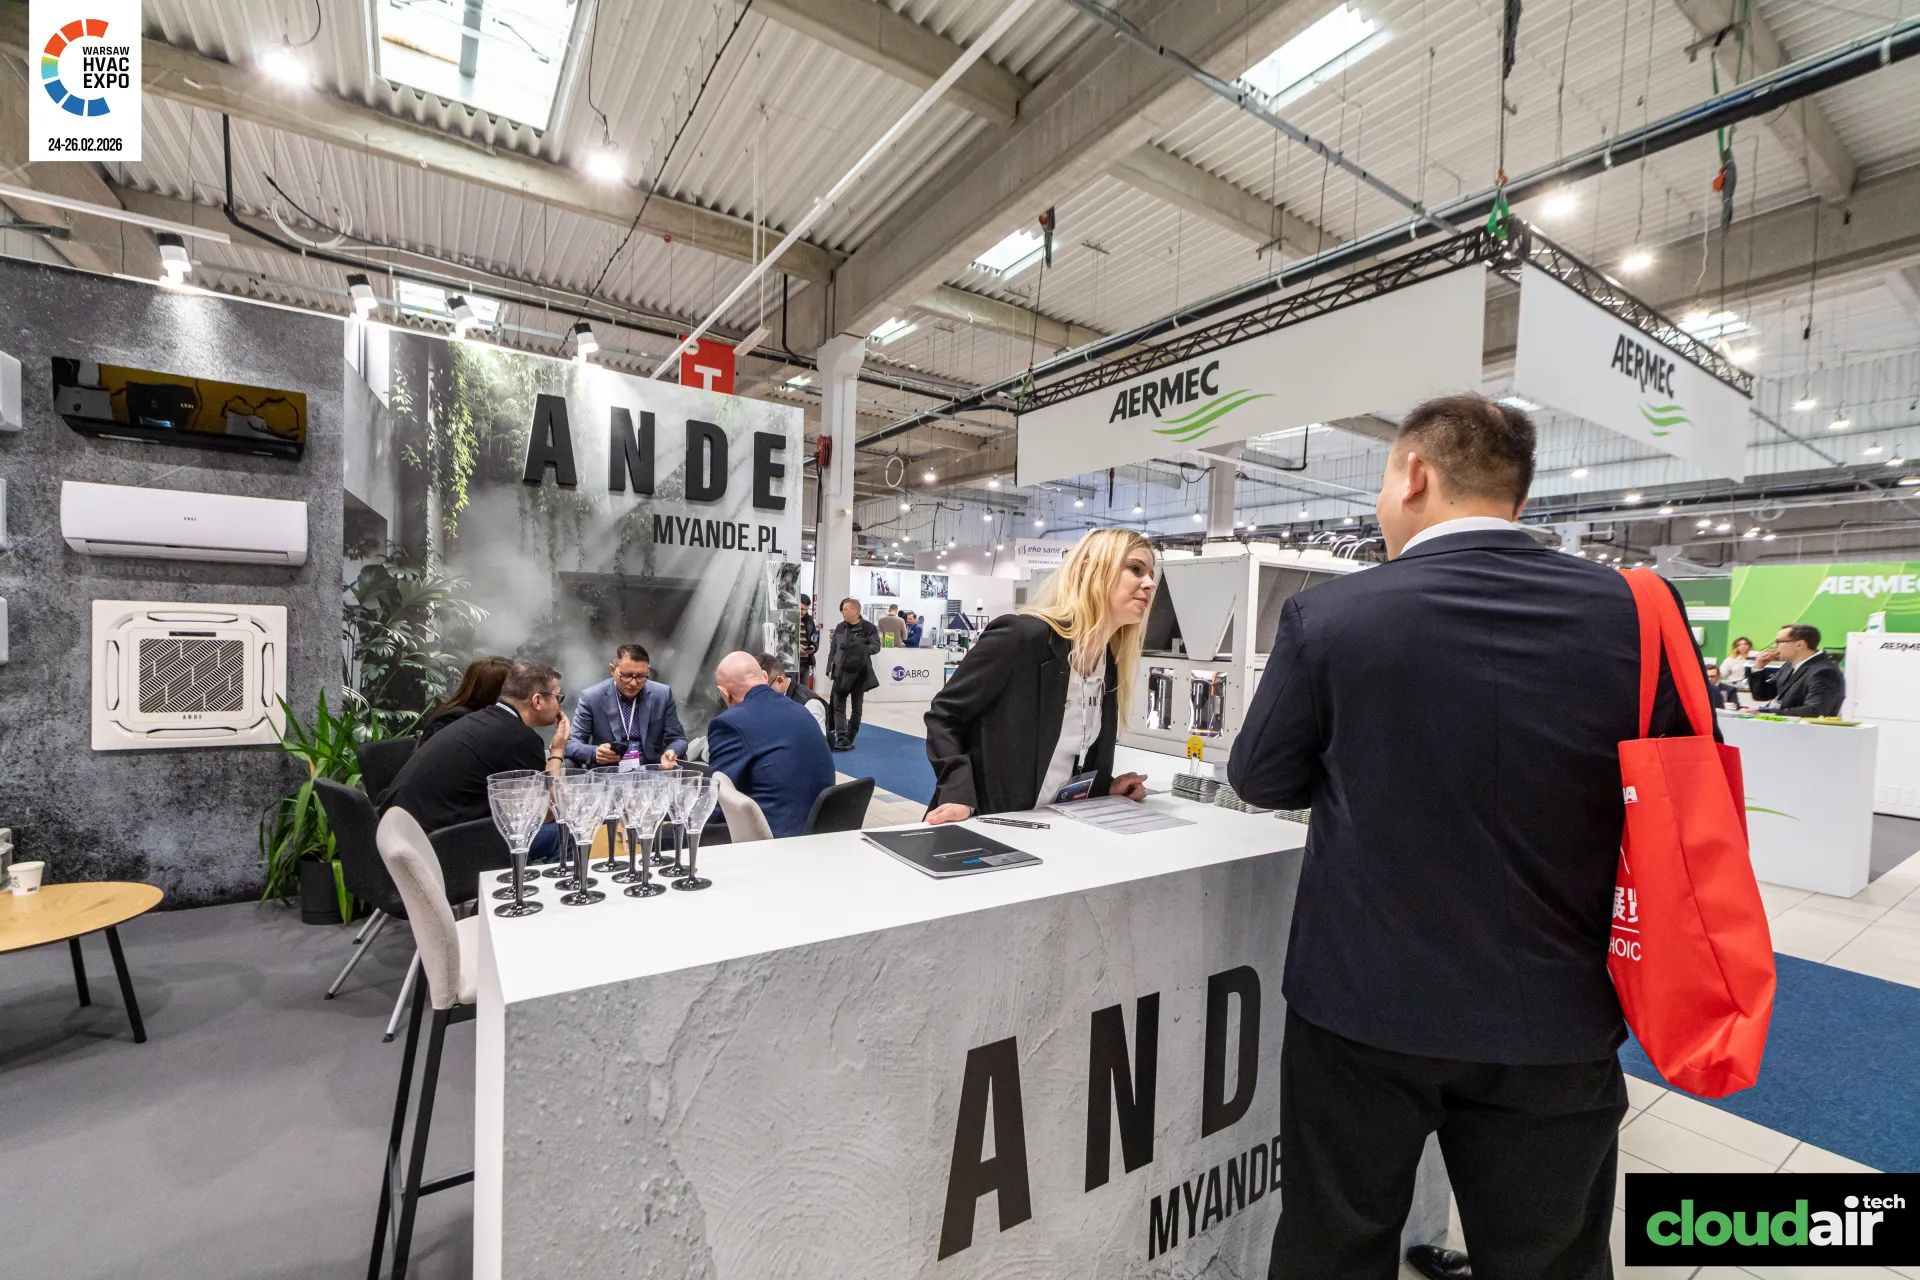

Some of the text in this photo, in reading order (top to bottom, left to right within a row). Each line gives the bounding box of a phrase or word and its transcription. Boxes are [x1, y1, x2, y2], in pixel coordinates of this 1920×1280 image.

[1109, 360, 1220, 424] AERMEC
[1611, 334, 1676, 399] AERMEC
[522, 393, 787, 511] ANDE
[653, 513, 783, 554] MYANDE.PL
[1815, 573, 1920, 599] AERME
[1622, 786, 1639, 802] A
